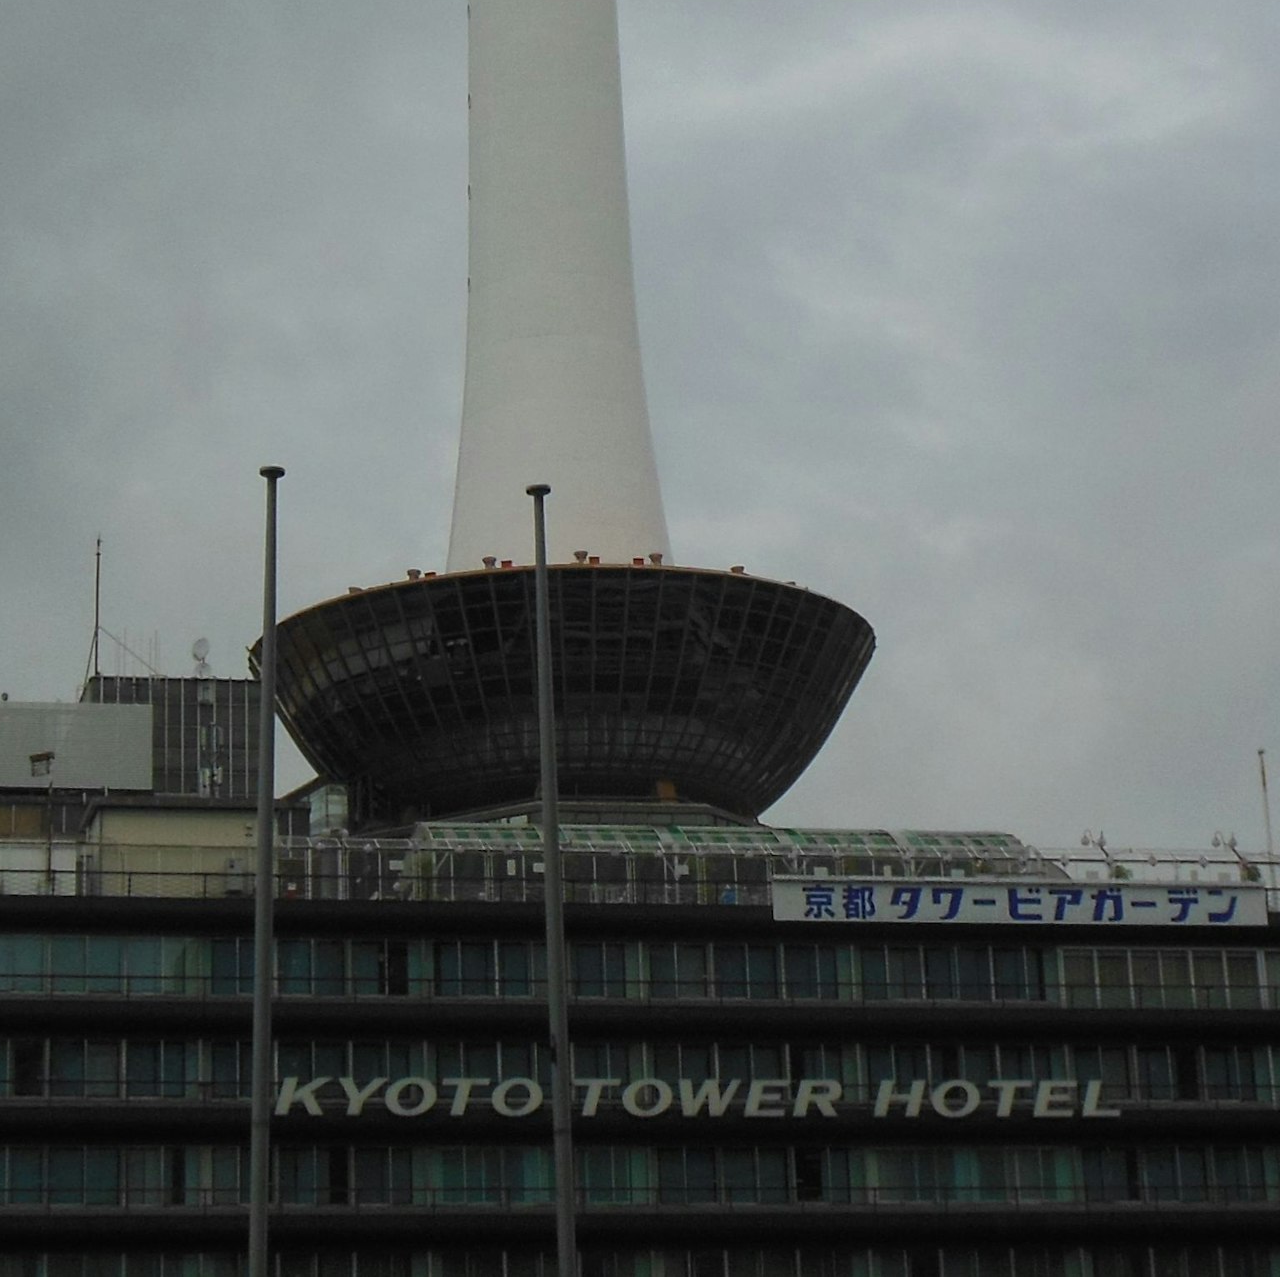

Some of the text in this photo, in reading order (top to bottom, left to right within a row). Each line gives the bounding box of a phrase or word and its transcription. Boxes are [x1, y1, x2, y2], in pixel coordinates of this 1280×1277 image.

[803, 885, 1237, 922] 京都タワービアガーデン
[274, 1077, 1121, 1118] KYOTO TOWER HOTEL
